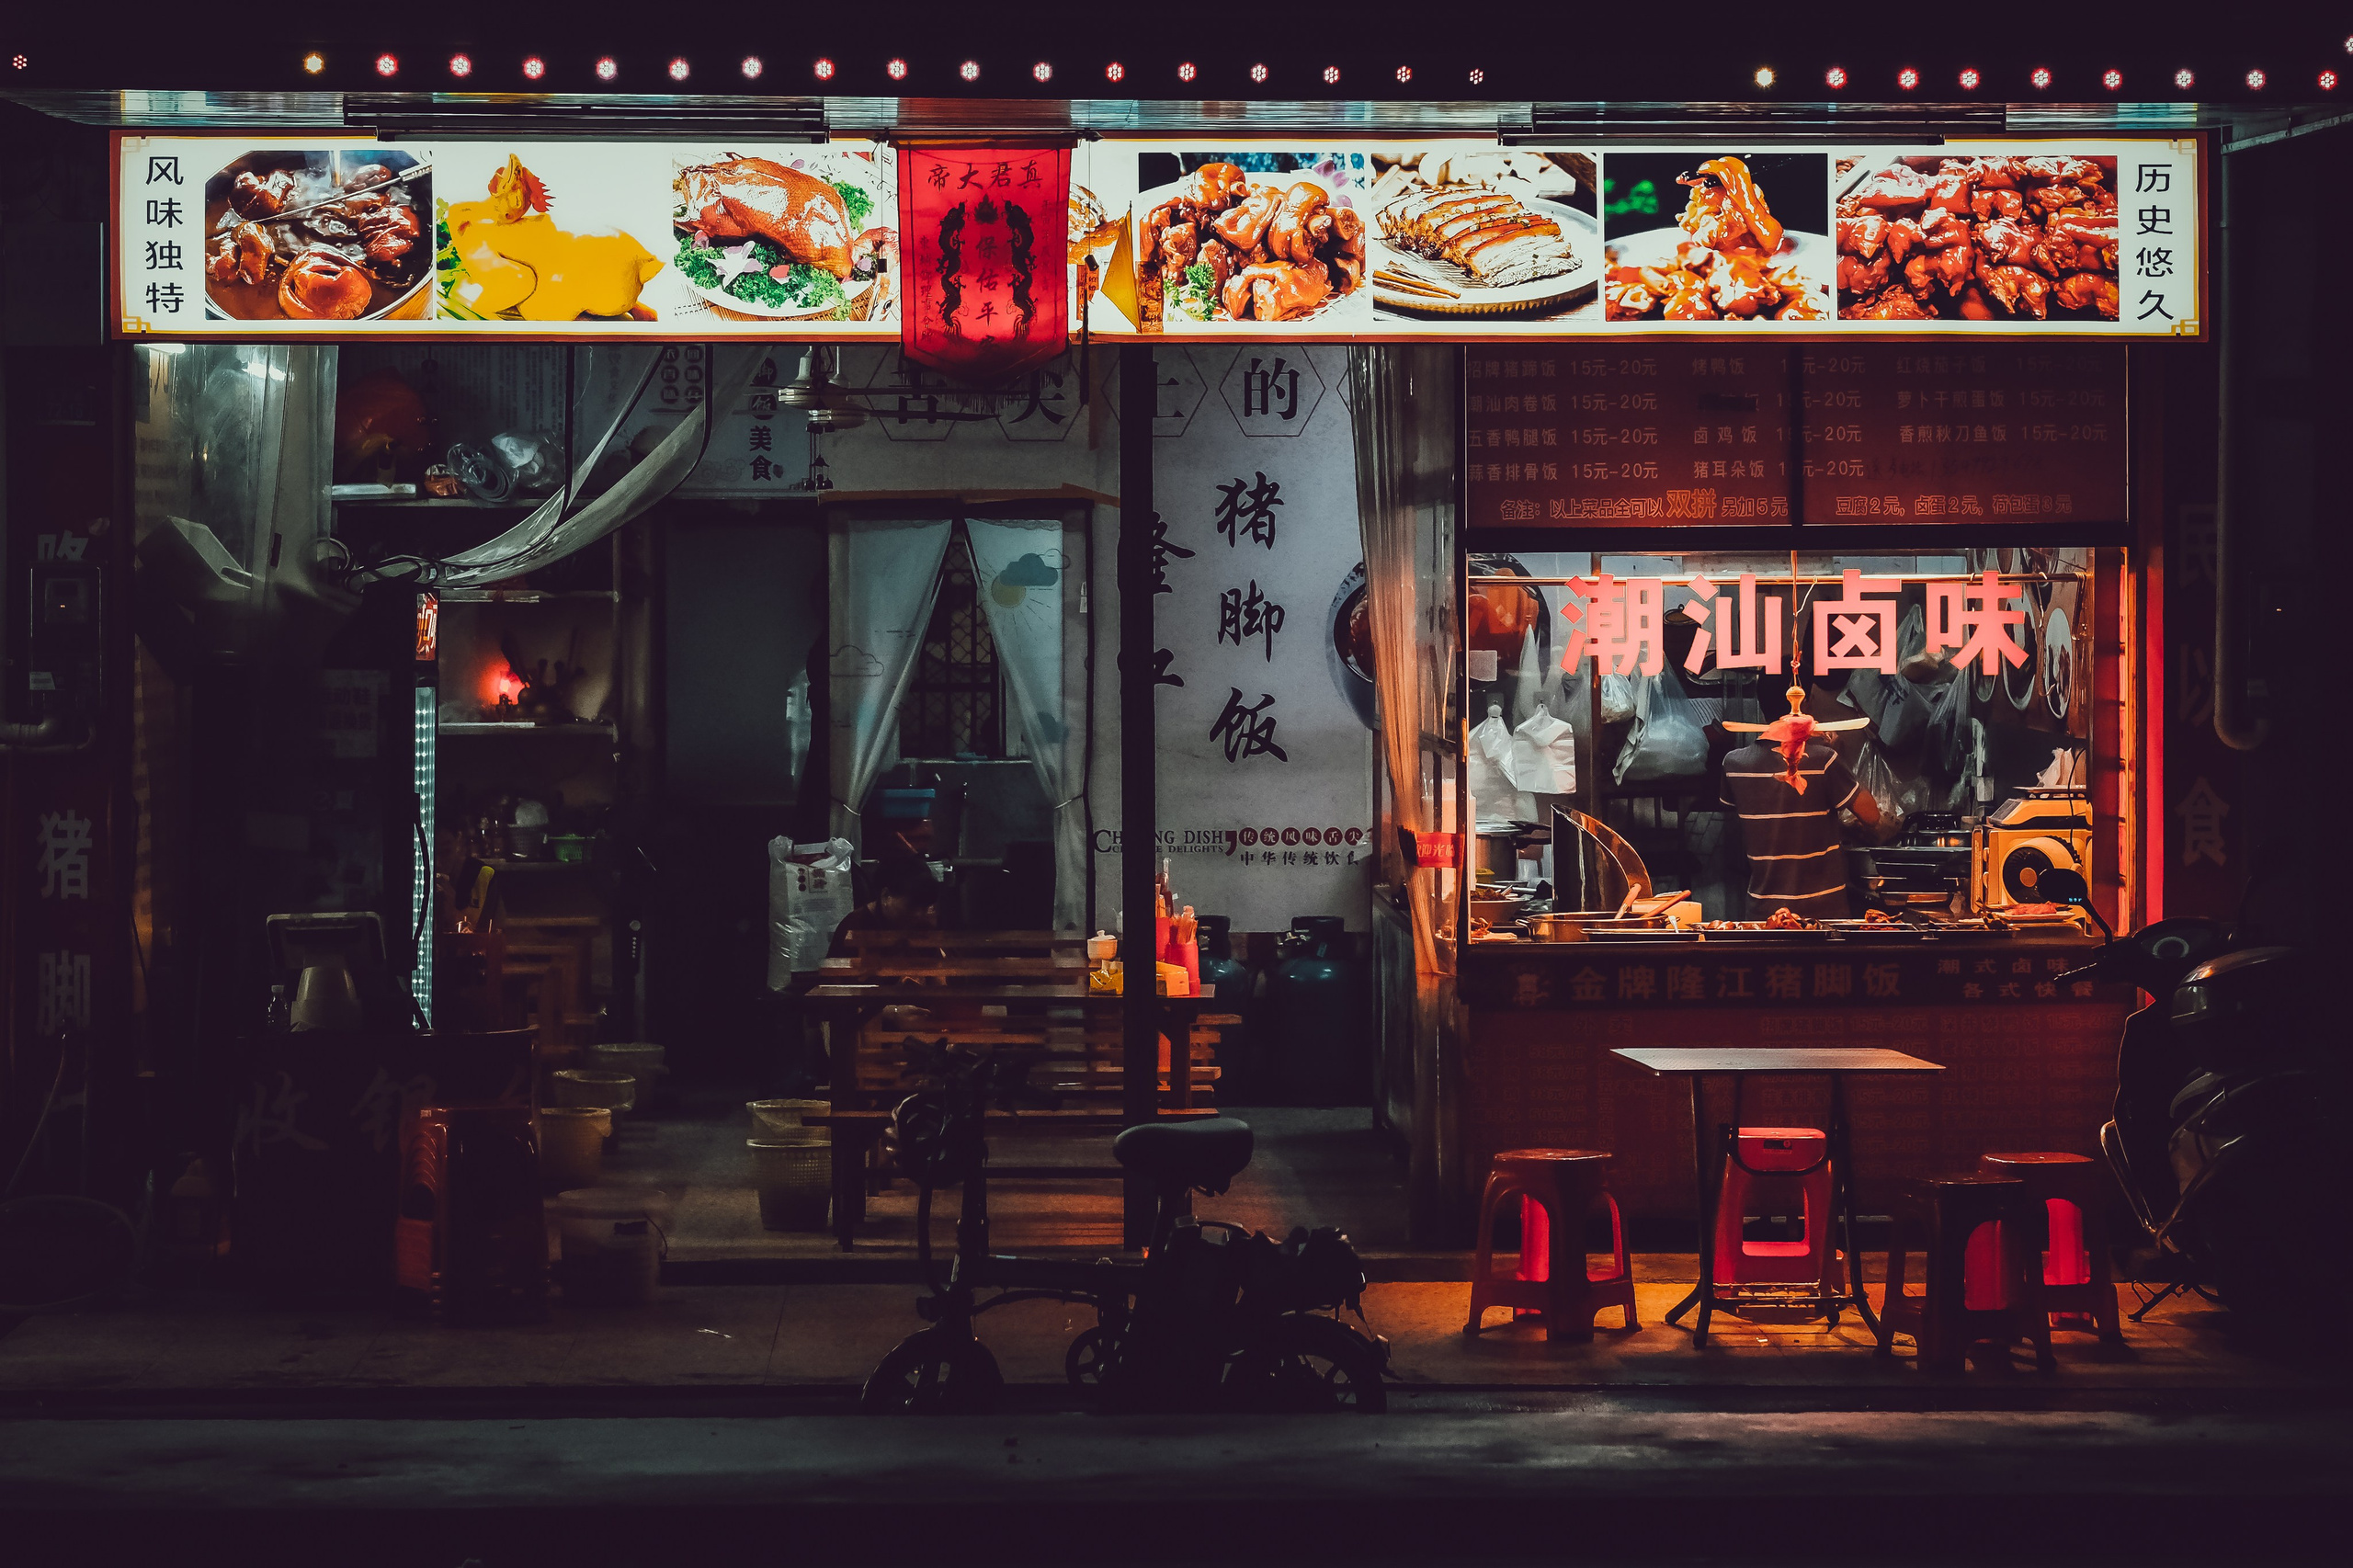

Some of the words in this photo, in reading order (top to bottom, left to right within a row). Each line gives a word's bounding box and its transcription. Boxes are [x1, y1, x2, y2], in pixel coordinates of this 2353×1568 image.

[145, 156, 184, 313] 风味独特
[2135, 164, 2174, 321] 历史悠久
[1570, 393, 1658, 412] 15元-20元
[1571, 427, 1658, 446] 15元-20元
[1571, 461, 1659, 480] 15元-20元
[1209, 472, 1288, 763] 猪脚饭
[1560, 569, 2030, 676] 潮汕卤味
[1184, 830, 1224, 845] DISH
[1936, 958, 2068, 975] 潮式卤味
[1568, 962, 1902, 1001] 金牌隆江猪脚饭
